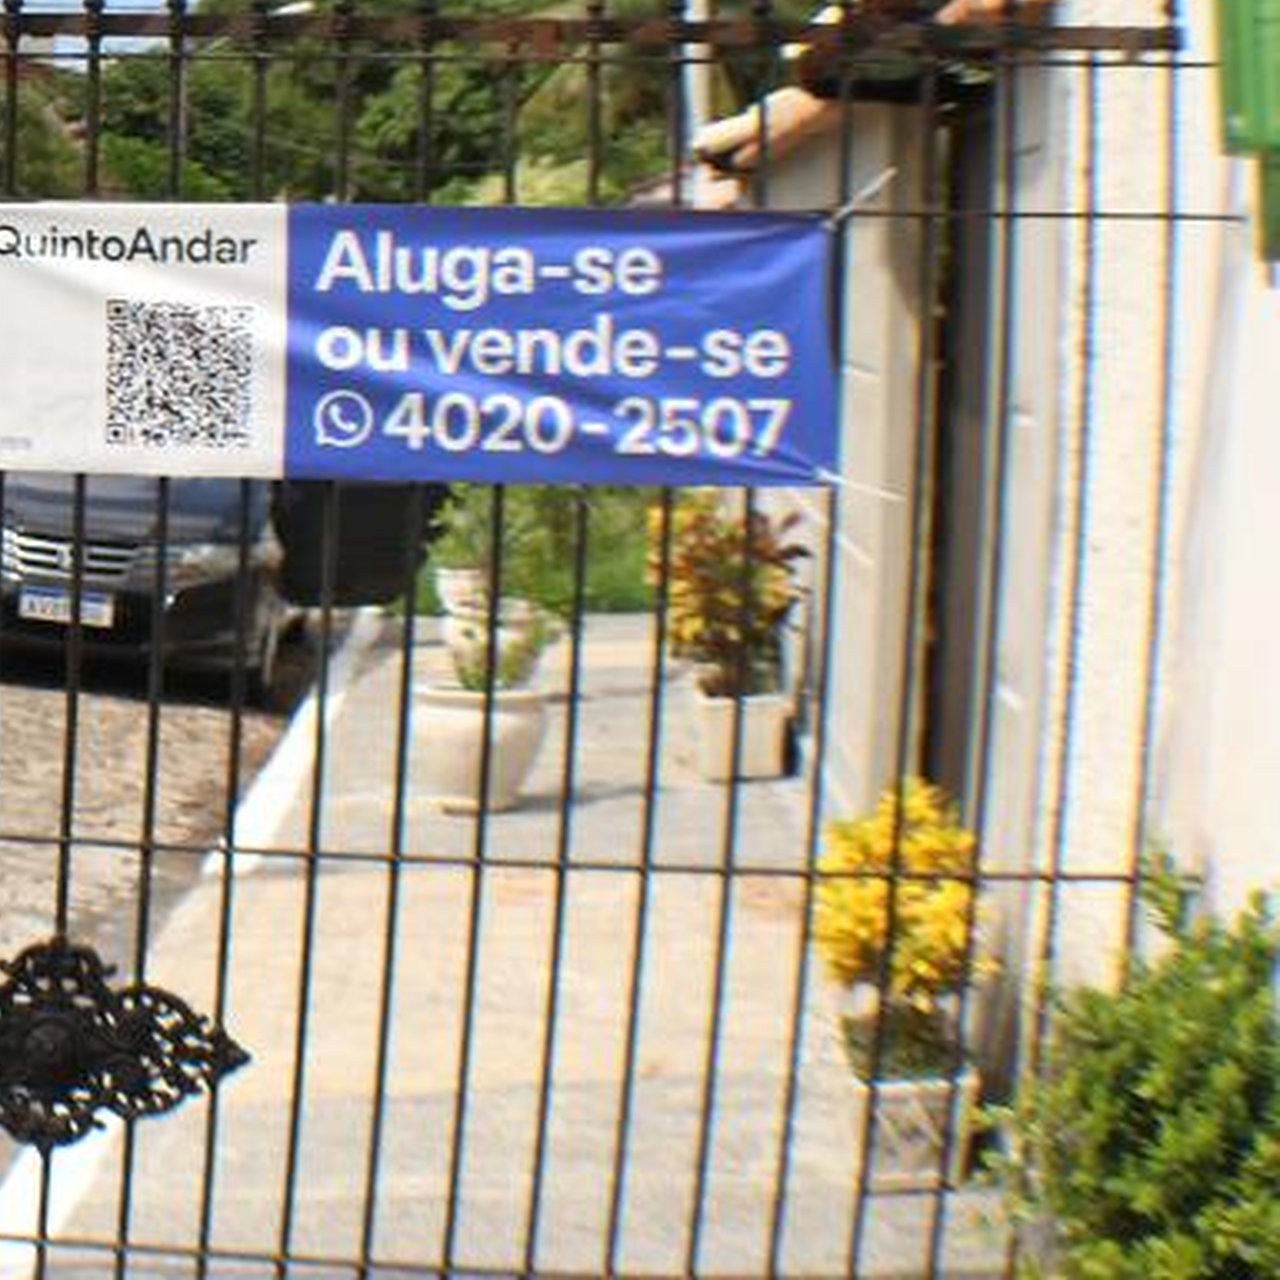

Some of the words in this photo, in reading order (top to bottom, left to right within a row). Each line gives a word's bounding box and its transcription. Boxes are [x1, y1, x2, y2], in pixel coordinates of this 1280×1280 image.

[314, 230, 663, 312] Aluga-se
[314, 323, 409, 373] ou
[428, 314, 791, 379] vende-se
[383, 390, 792, 459] 4020-2507
